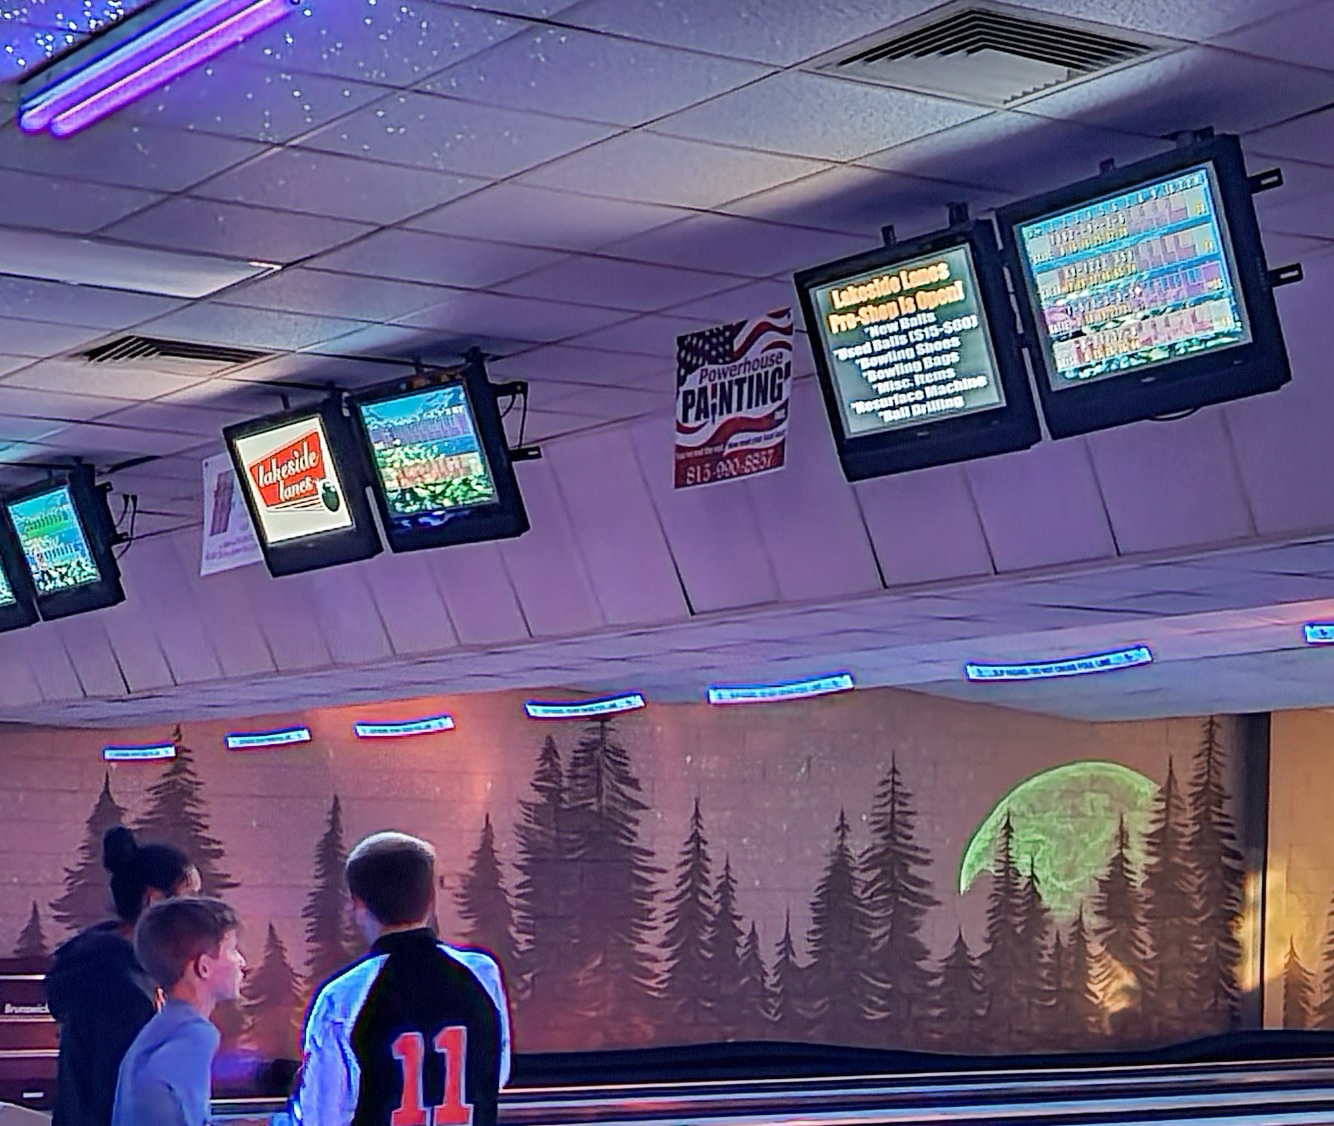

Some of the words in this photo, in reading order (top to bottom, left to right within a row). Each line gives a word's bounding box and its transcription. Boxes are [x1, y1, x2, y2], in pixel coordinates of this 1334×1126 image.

[830, 274, 901, 310] Lakeside
[899, 262, 950, 291] Lanes
[827, 301, 899, 334] Pro-Shop
[915, 280, 965, 311] Open!
[899, 312, 937, 330] Balls
[872, 333, 908, 352] Balls
[915, 336, 961, 356] Shoes
[698, 351, 784, 385] Powerhouse
[922, 351, 960, 371] Bags
[914, 367, 956, 386] Items
[925, 375, 988, 397] Machine
[681, 366, 786, 424] PAINTING
[911, 395, 965, 416] Drilling
[258, 440, 318, 488] lakeside
[278, 475, 314, 501] lanes
